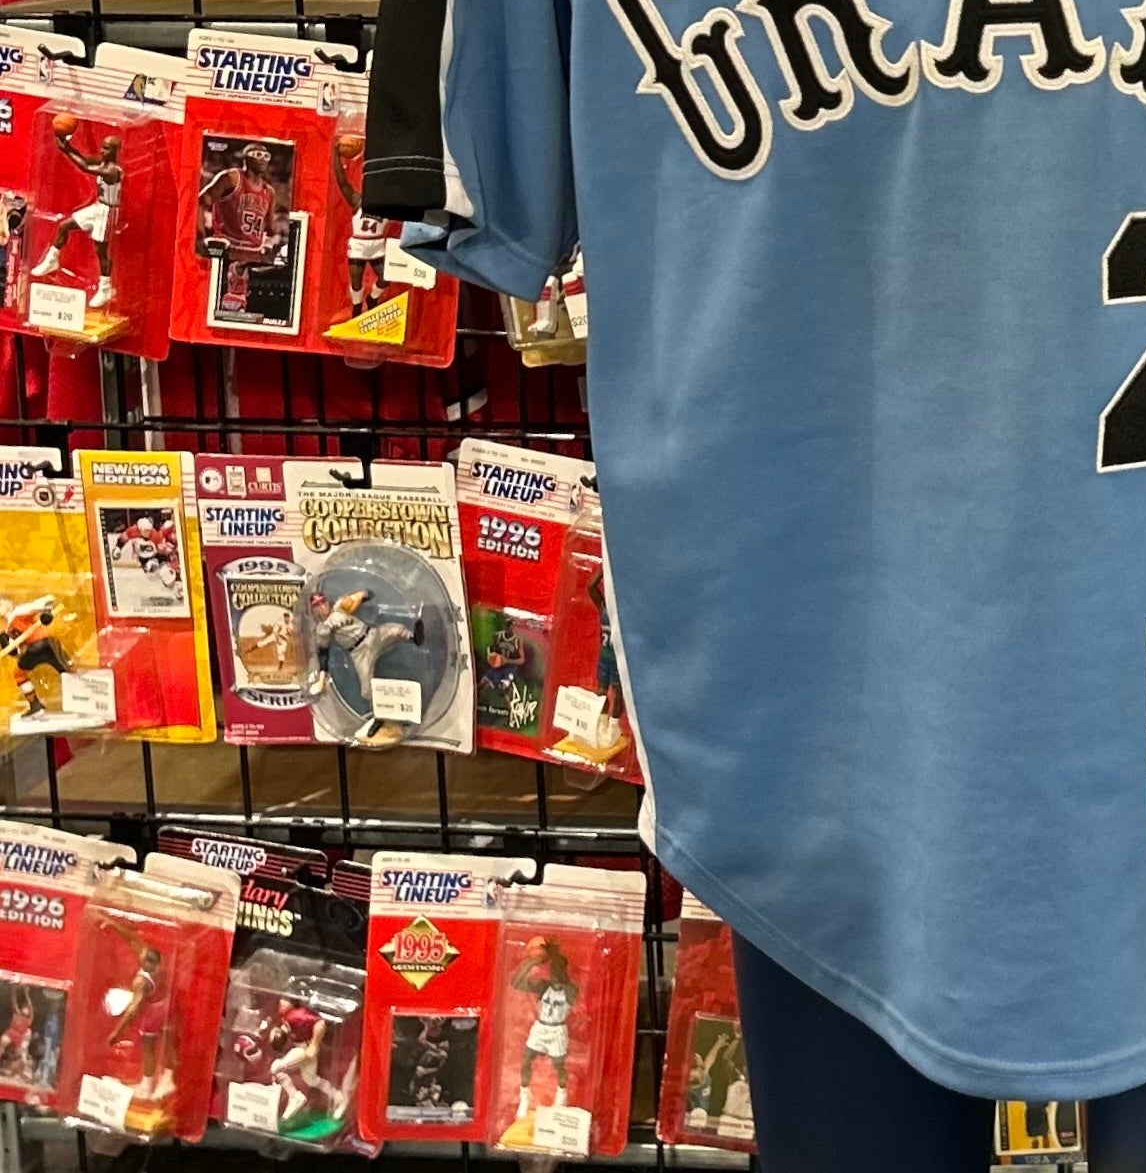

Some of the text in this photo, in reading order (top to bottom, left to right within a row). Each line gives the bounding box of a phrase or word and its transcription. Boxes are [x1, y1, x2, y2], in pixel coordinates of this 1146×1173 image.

[198, 47, 312, 77] STARTING
[213, 69, 297, 96] LINEUP
[242, 212, 263, 238] 54
[358, 303, 399, 326] COLLECTOR
[93, 463, 170, 476] NEW 1994
[94, 474, 171, 486] EDITION
[472, 461, 557, 492] STARTING
[483, 480, 544, 504] LINEUP
[205, 507, 285, 522] STARTING
[300, 498, 450, 524] COOPERSTOWN
[218, 520, 276, 537] LINEUP
[303, 516, 455, 559] COLLECTION
[478, 515, 542, 546] 1996
[477, 537, 540, 561] EDITION
[238, 560, 290, 575] 1995
[233, 591, 301, 609] COLLECTION
[0, 840, 77, 866] TARTING
[194, 839, 263, 862] STARTING
[4, 856, 65, 877] LINEUP
[204, 853, 253, 873] LINEUP
[382, 869, 471, 888] STARTING
[0, 888, 65, 915] 1996
[394, 885, 459, 903] LINEUP
[391, 931, 448, 962] 1995
